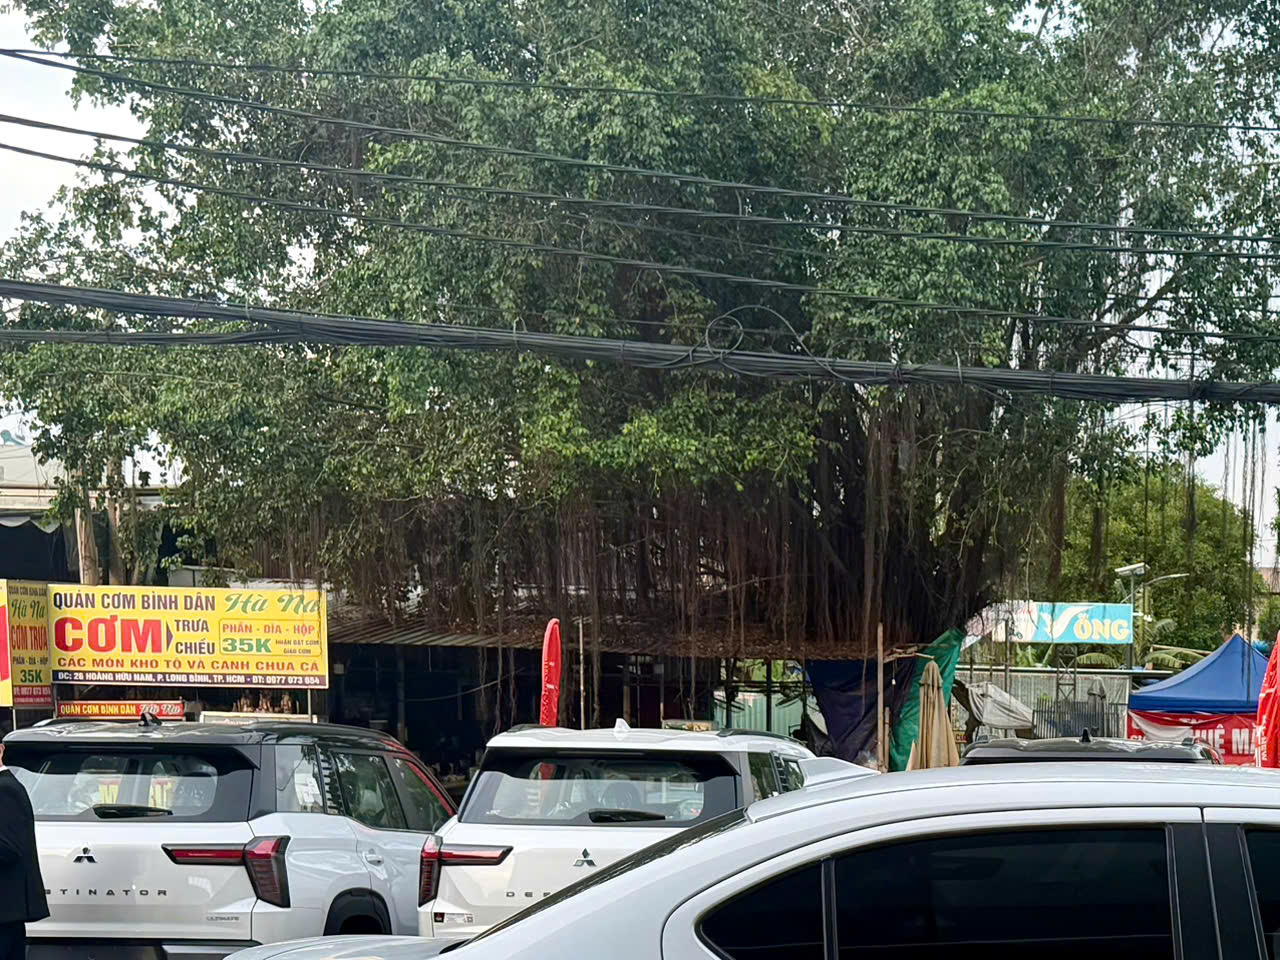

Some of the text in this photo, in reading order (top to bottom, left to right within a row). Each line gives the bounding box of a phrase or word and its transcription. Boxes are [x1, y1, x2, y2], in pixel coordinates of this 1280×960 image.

[53, 590, 95, 609] QUÁN
[101, 592, 135, 610] CƠM
[142, 591, 178, 611] BÌNH
[184, 592, 216, 611] DÂN
[225, 593, 268, 614] Hà
[174, 619, 210, 633] TRƯA
[55, 615, 162, 653] CƠM
[222, 638, 272, 653] 35K
[57, 656, 86, 668] CÁC
[130, 659, 159, 669] KHO
[211, 660, 250, 671] CANH
[255, 660, 295, 671] CHUA
[20, 669, 43, 683] 35K
